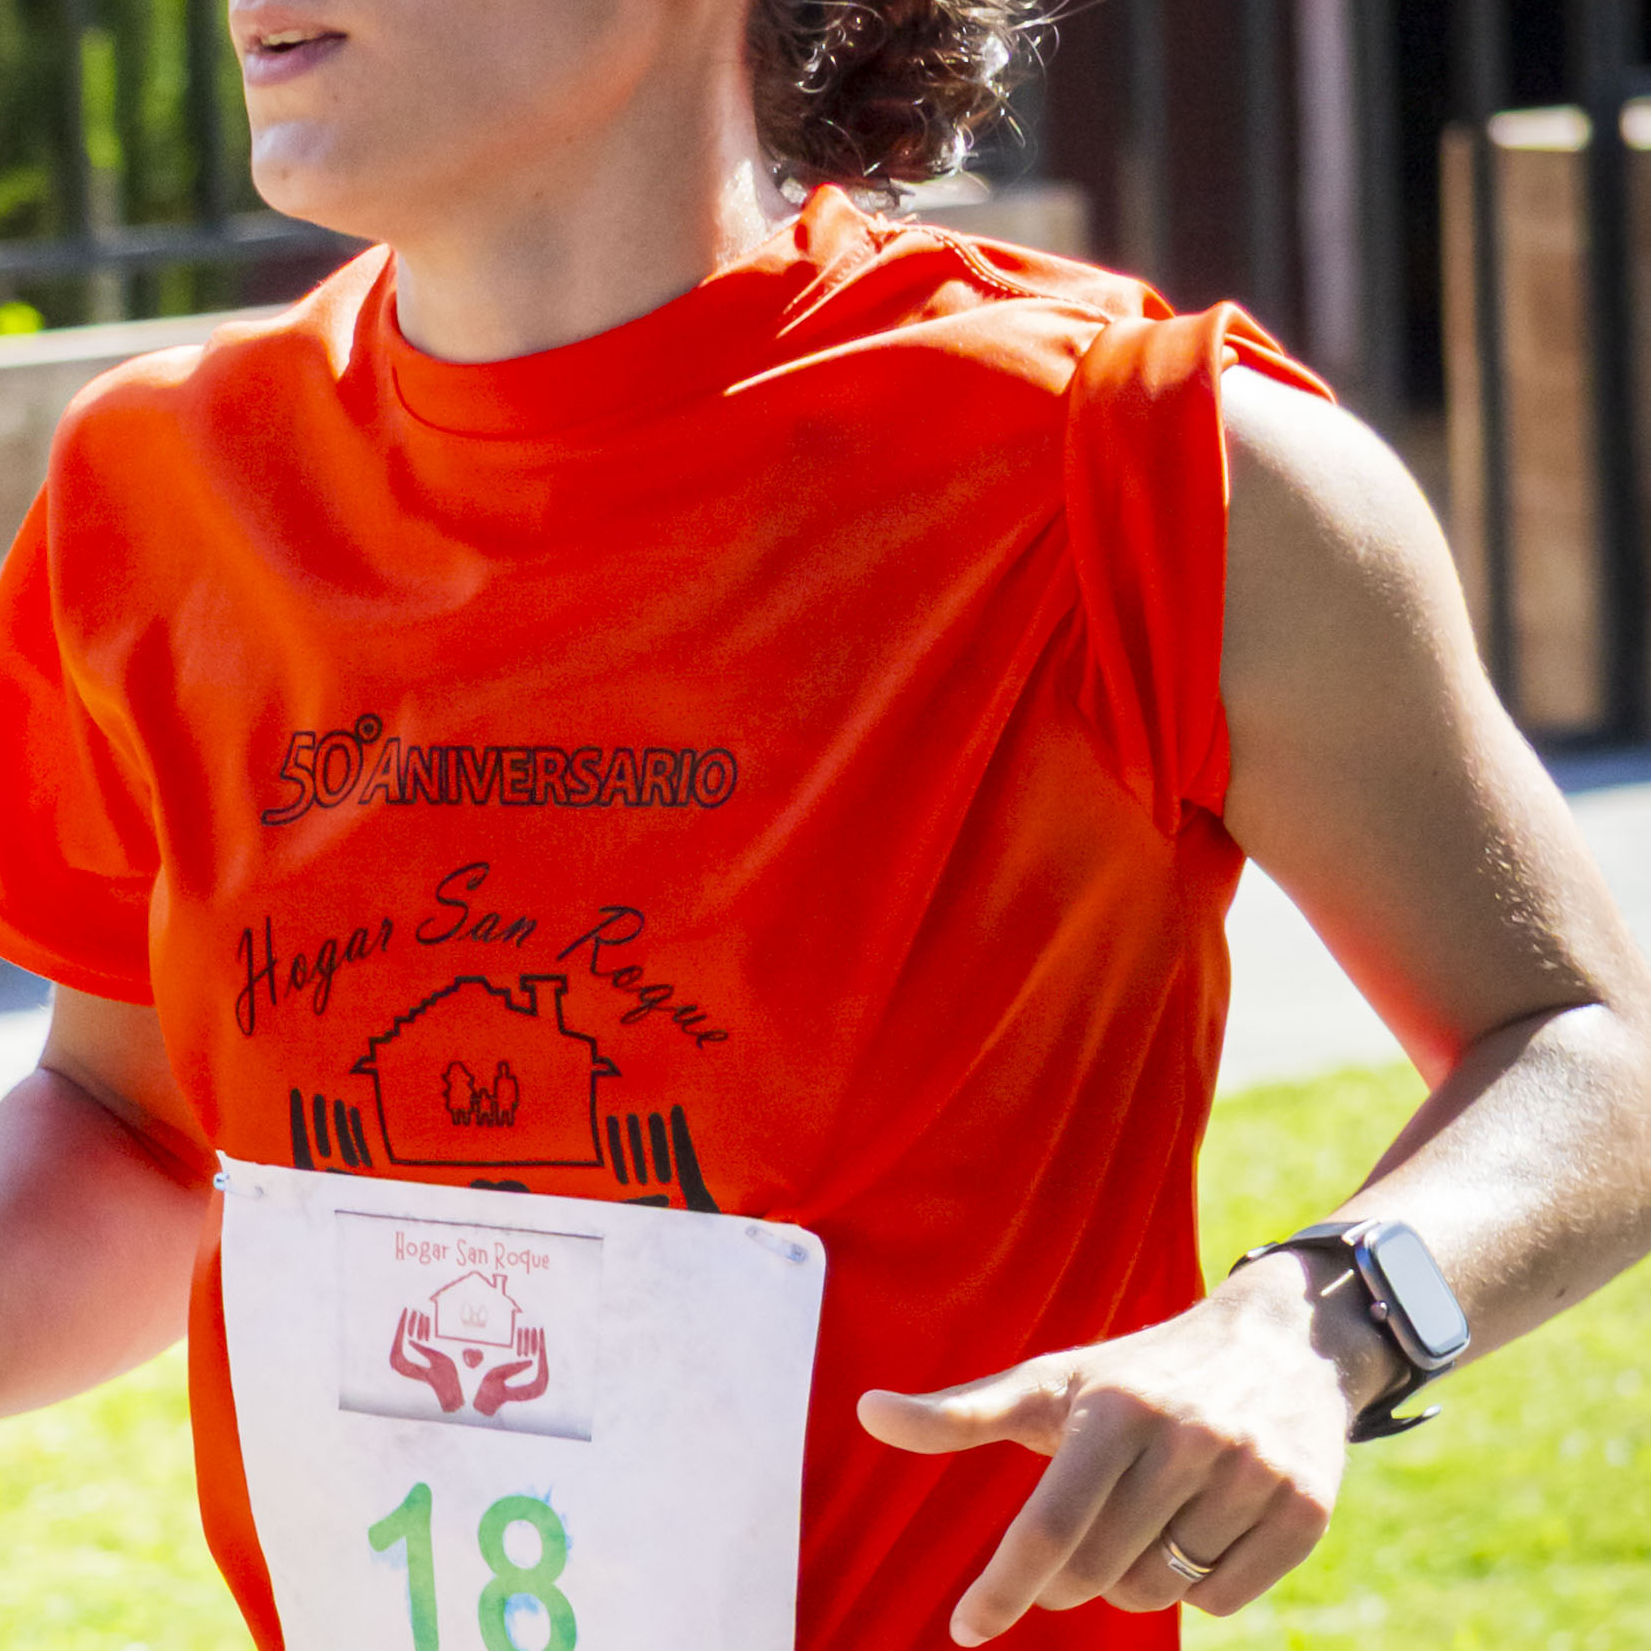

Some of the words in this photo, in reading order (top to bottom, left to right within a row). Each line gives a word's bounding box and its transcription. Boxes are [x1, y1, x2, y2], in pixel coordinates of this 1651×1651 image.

[236, 915, 393, 1036] Hogar
[415, 861, 537, 948] San
[395, 1231, 450, 1265] Hogar
[456, 1238, 488, 1266] San
[494, 1242, 550, 1275] Roque
